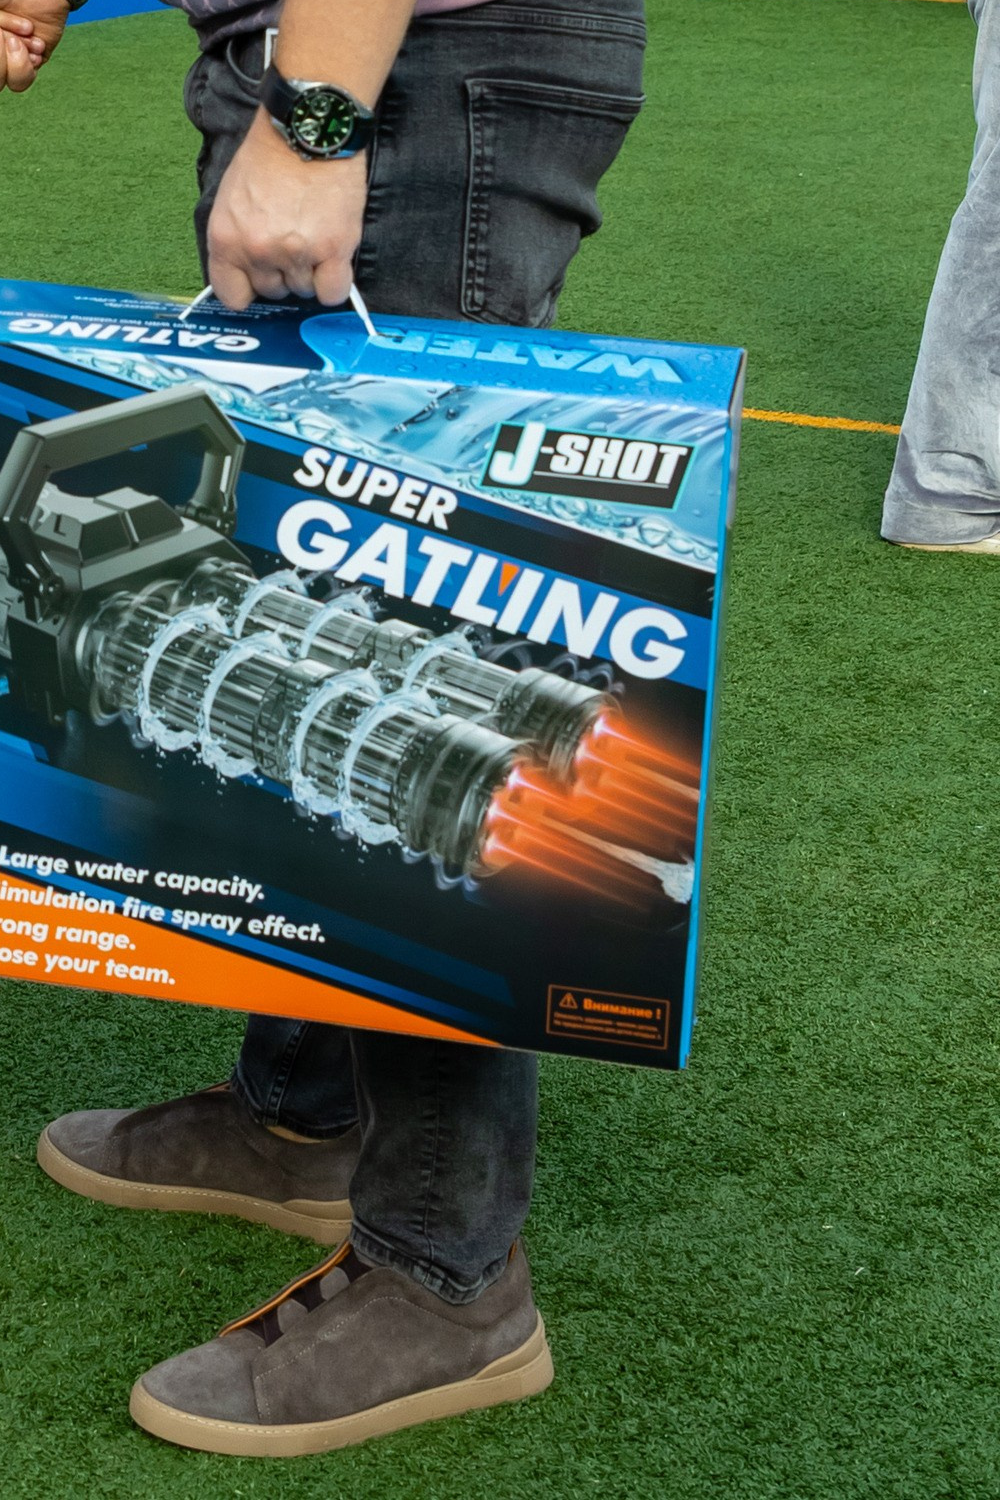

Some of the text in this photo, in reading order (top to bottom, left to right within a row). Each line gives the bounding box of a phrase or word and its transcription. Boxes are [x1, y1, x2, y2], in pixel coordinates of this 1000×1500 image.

[7, 317, 261, 353] GATLING
[370, 326, 683, 384] WATER
[488, 422, 689, 486] J-SHOT
[293, 447, 458, 531] SUPER
[275, 499, 688, 680] GATLING
[75, 859, 149, 885] water
[154, 870, 266, 903] capacity.
[55, 923, 137, 953] range.
[122, 896, 166, 923] fire
[171, 907, 243, 937] spray
[247, 916, 326, 944] effect.
[43, 951, 100, 975] your
[105, 958, 176, 985] team.
